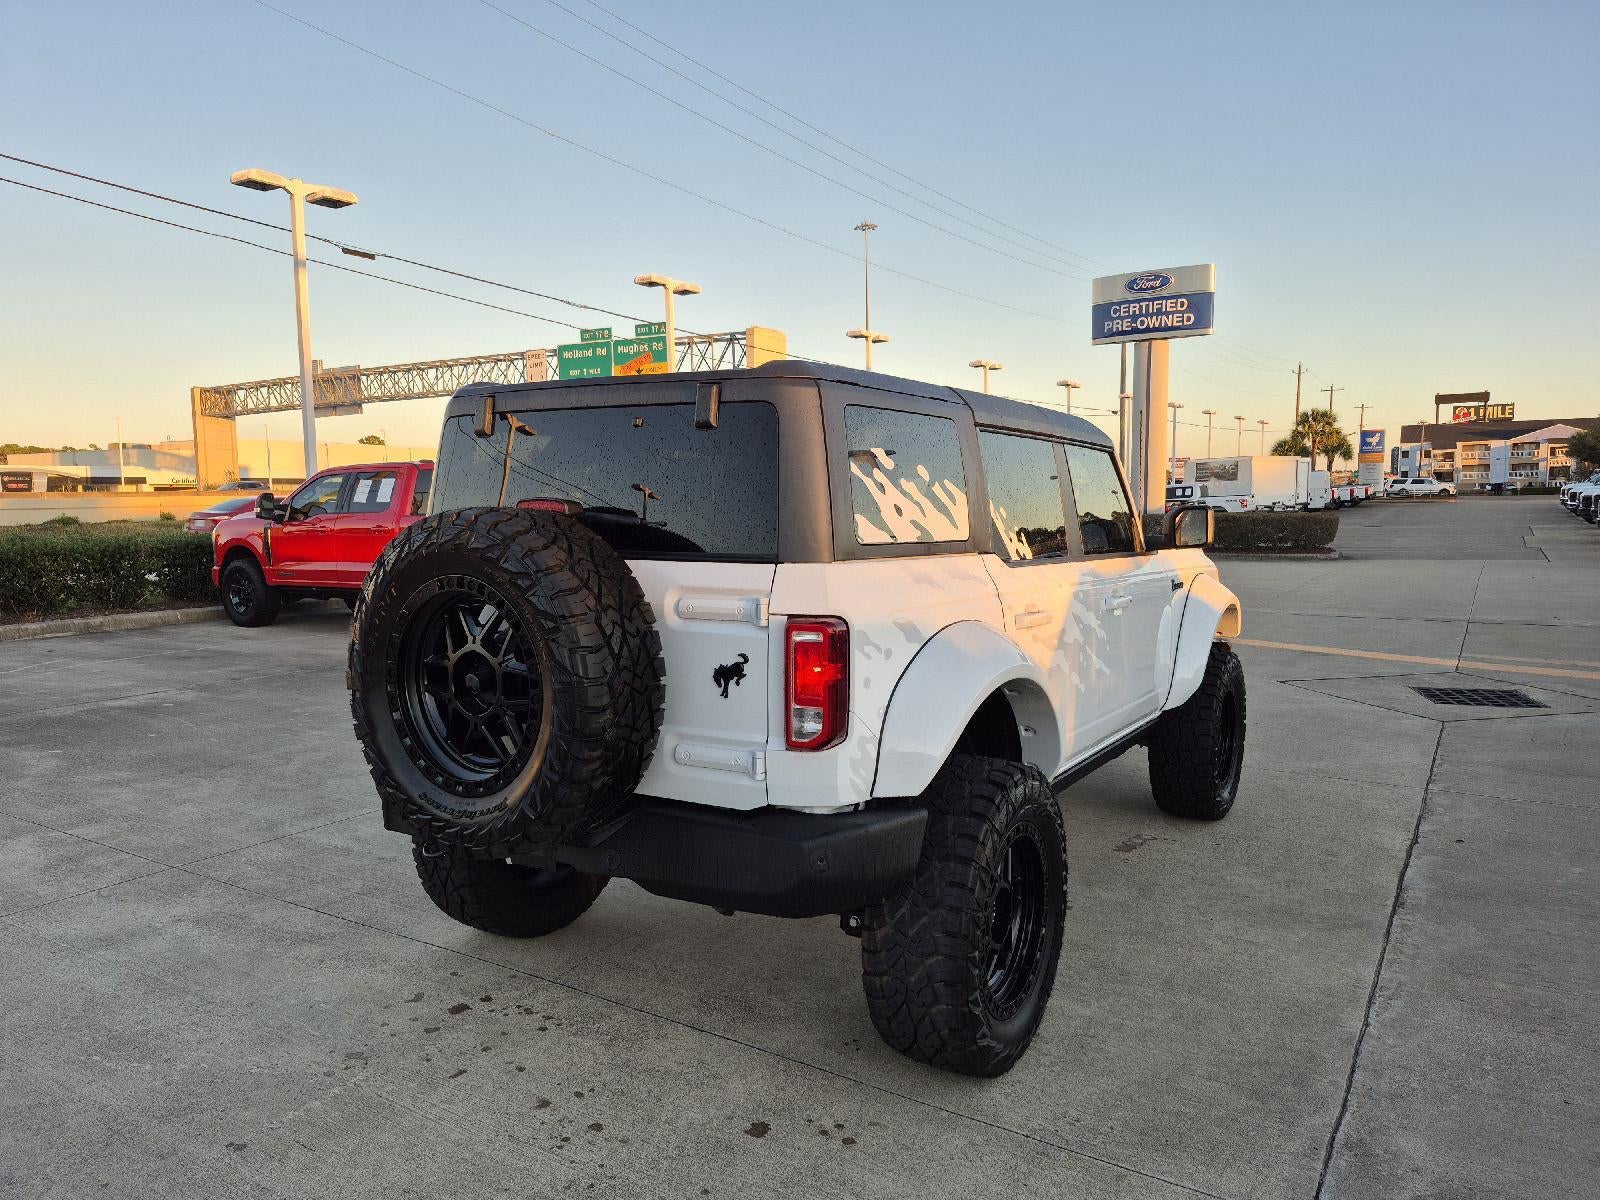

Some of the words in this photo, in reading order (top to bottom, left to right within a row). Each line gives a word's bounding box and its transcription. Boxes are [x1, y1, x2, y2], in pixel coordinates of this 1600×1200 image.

[1133, 276, 1162, 290] Ford
[1110, 299, 1188, 318] CERTIFIED
[1104, 313, 1195, 333] PRE-OWNED
[563, 348, 593, 359] Holland
[596, 346, 607, 356] Rd
[617, 343, 649, 355] Hughes
[652, 341, 664, 351] Rd
[529, 361, 544, 369] LIMIT
[1479, 405, 1514, 419] MILE
